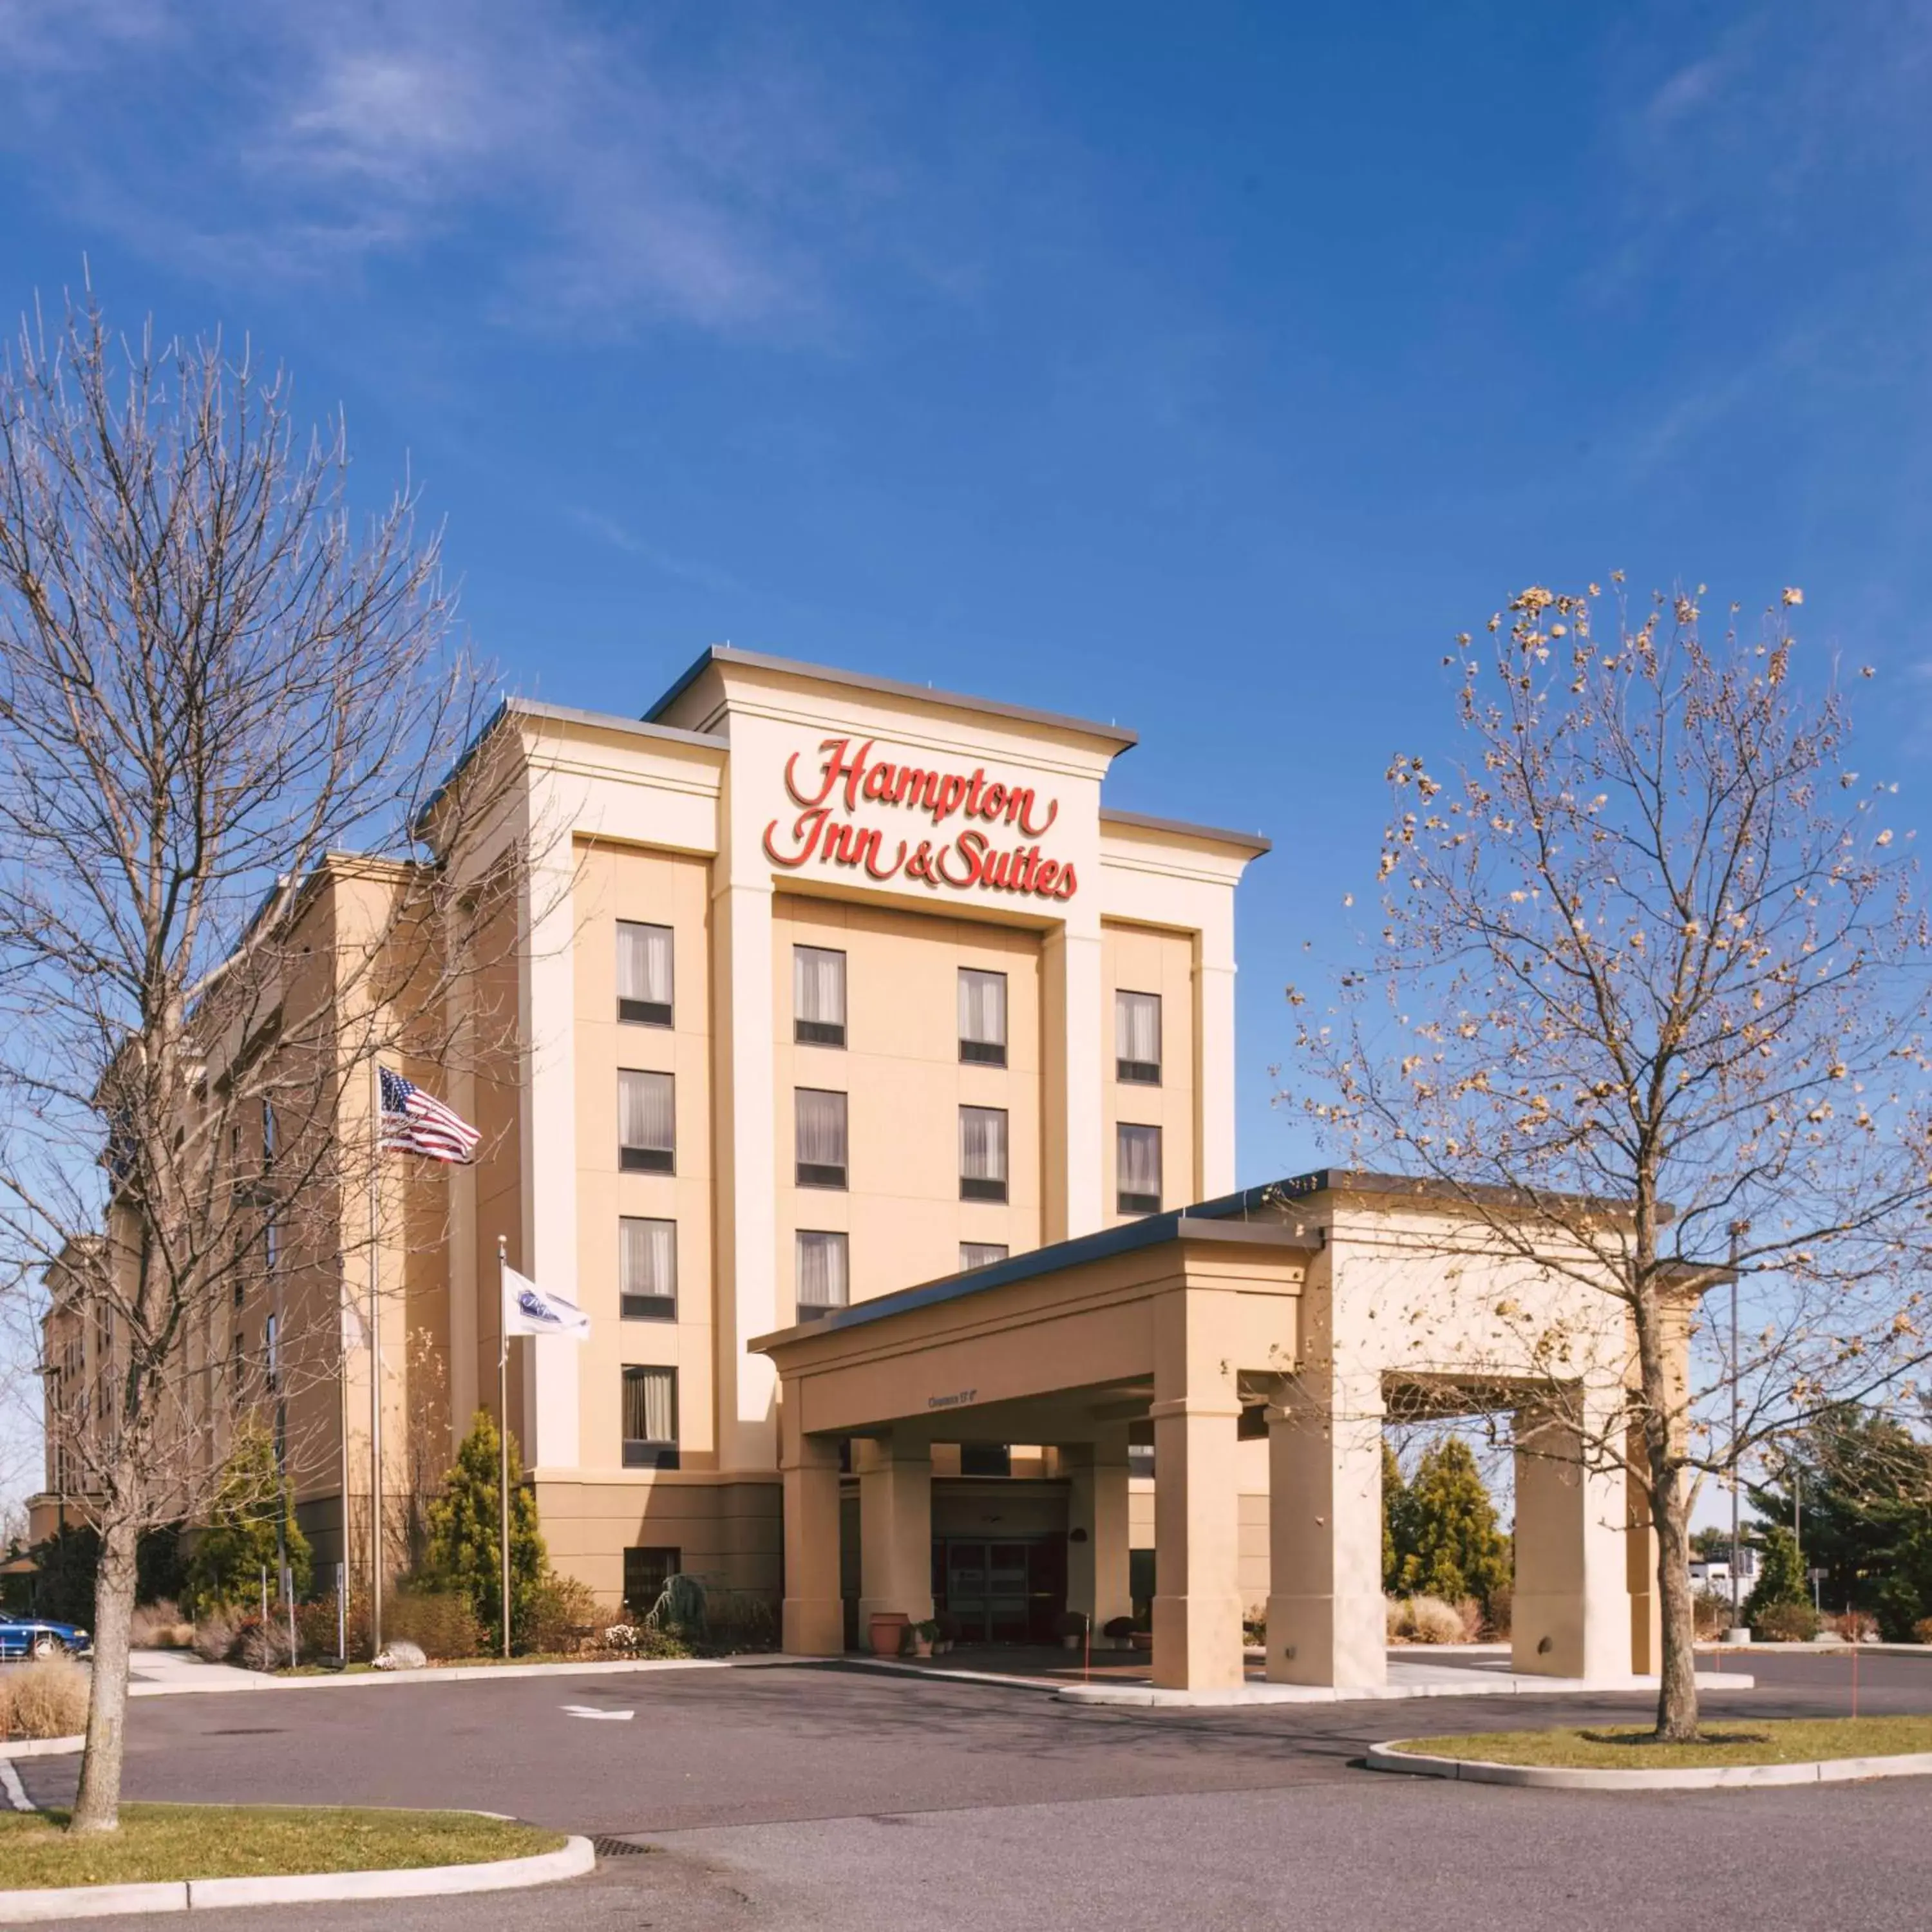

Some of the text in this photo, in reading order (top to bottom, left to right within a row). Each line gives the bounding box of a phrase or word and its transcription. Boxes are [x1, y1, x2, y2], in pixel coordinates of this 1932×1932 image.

[785, 739, 1058, 835] Hampton
[764, 807, 1078, 899] Inn & Suites
